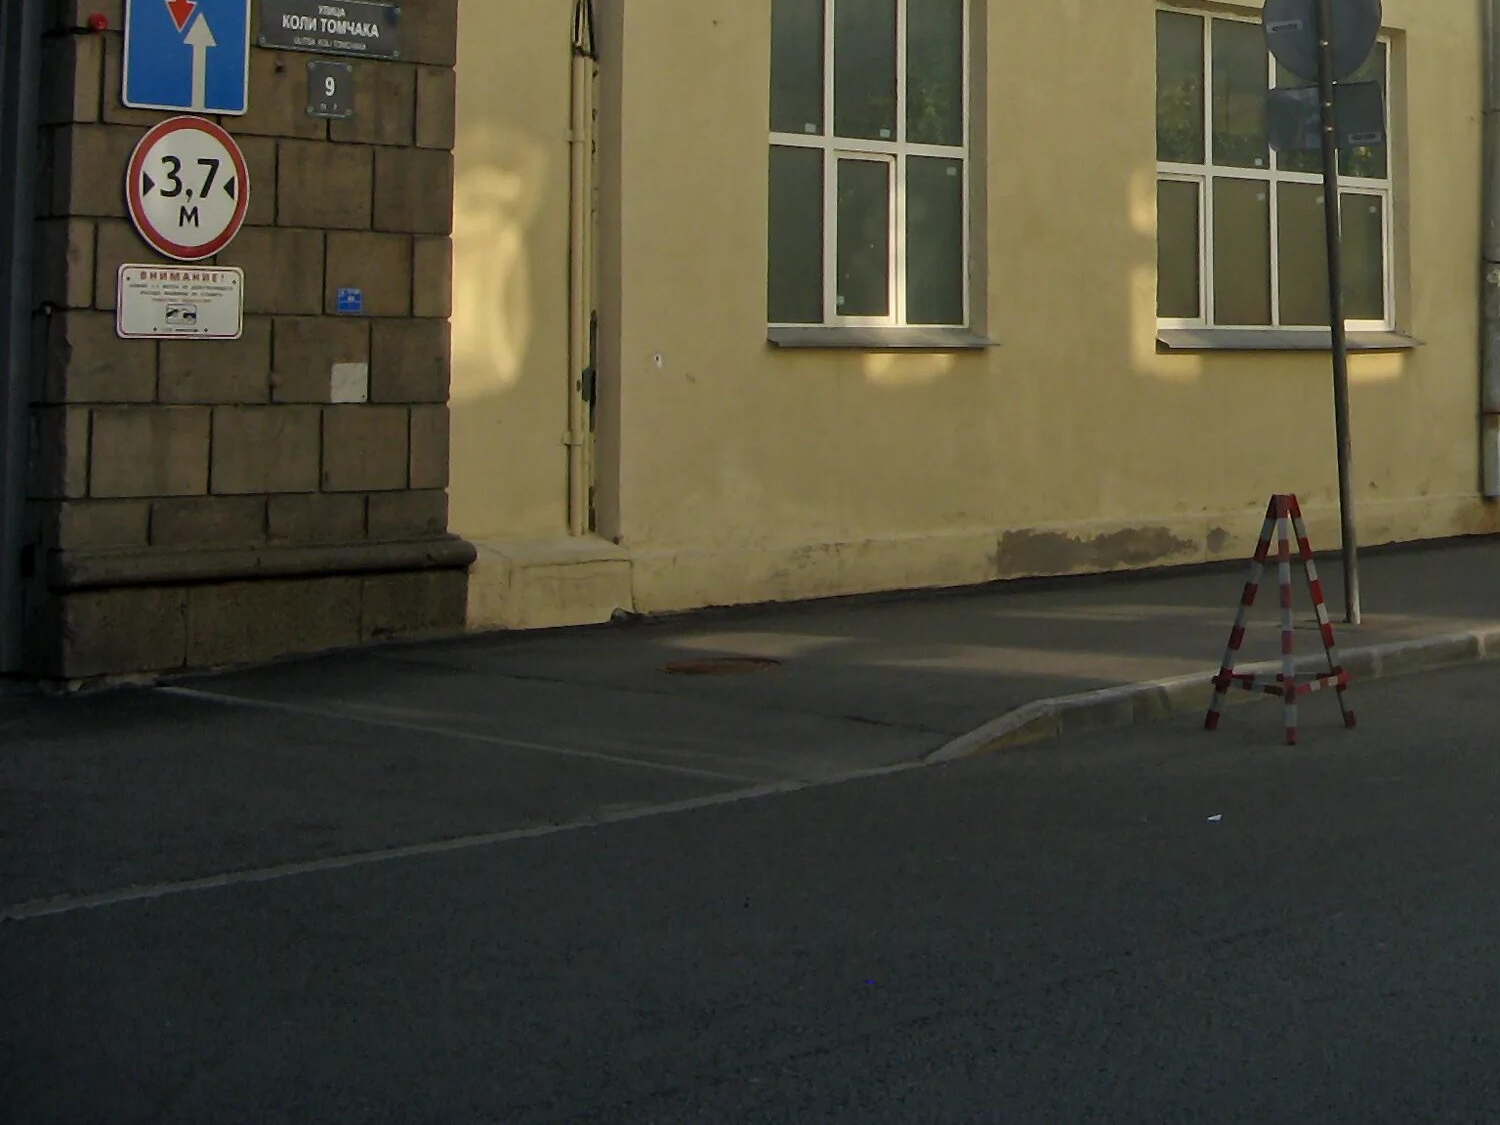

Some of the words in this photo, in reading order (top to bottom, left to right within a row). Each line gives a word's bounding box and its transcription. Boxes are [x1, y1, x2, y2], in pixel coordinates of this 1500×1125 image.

[282, 14, 317, 31] КОЛИ
[320, 18, 380, 38] ТОМЧАКА
[325, 76, 335, 96] 9
[160, 155, 220, 203] 3,7
[140, 271, 224, 283] ВНИМАНИЕ!
